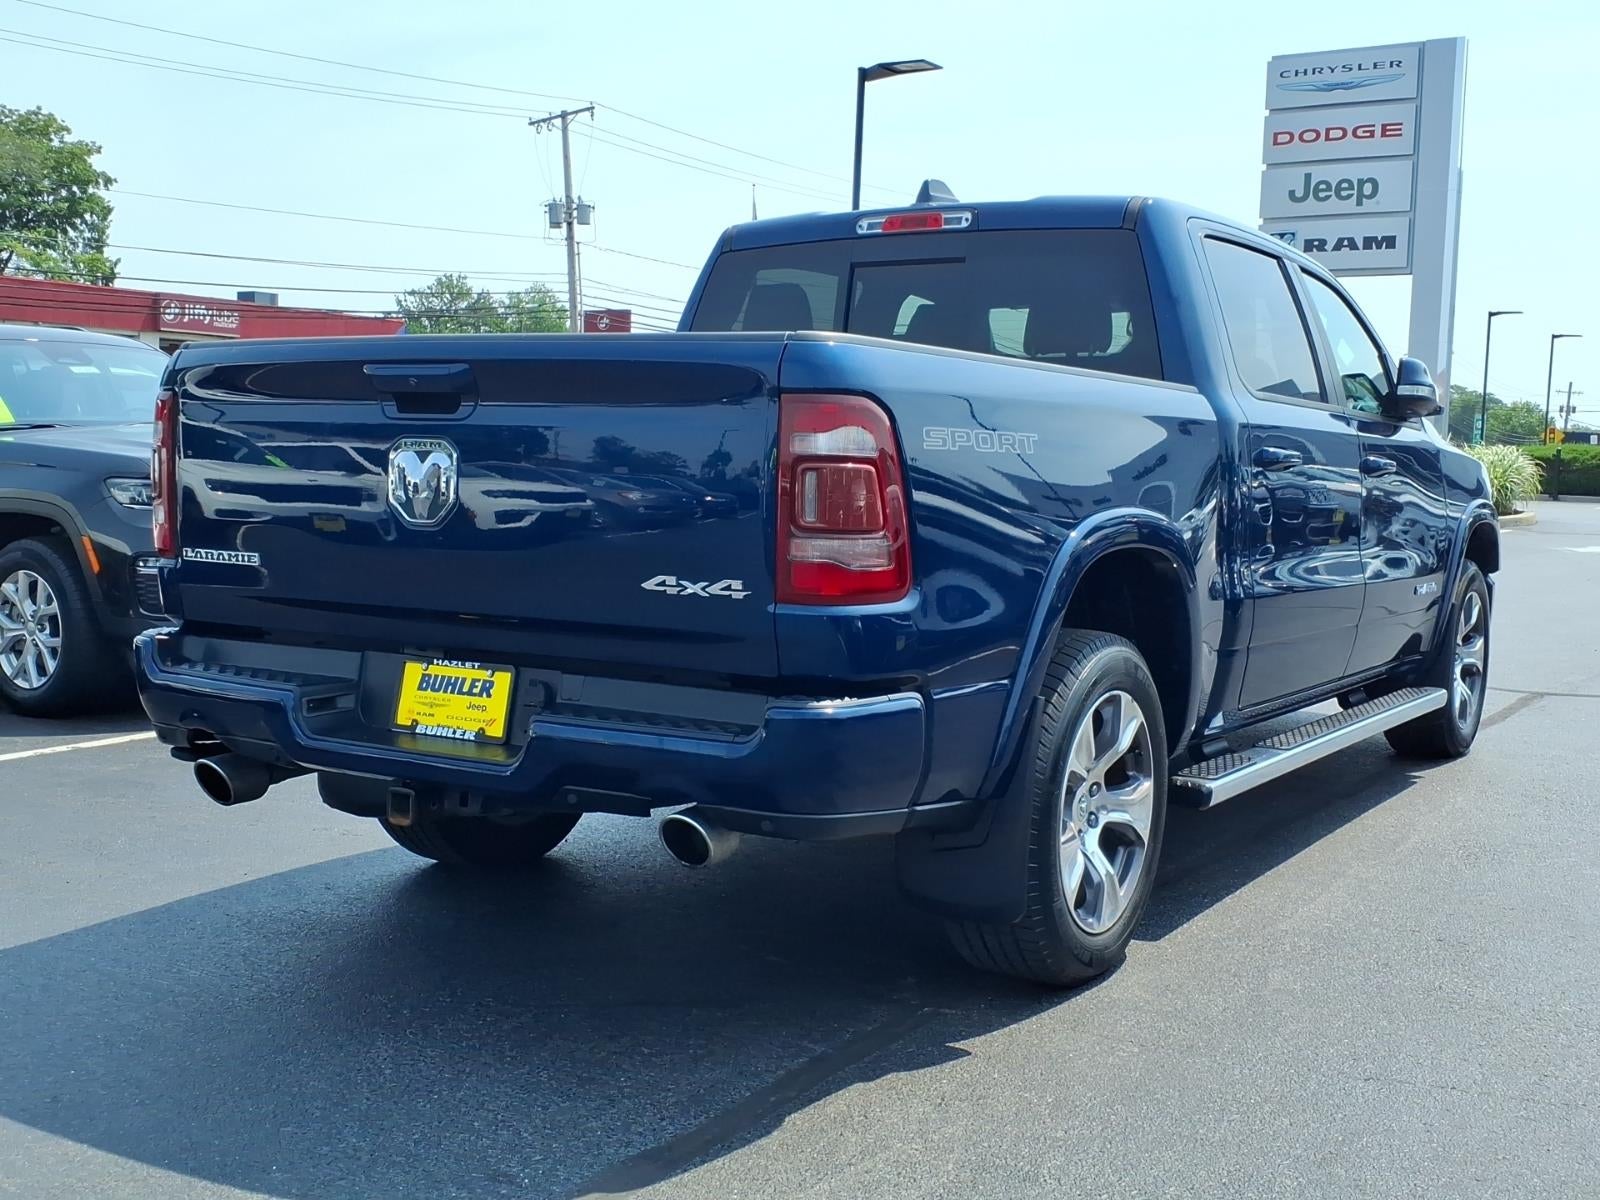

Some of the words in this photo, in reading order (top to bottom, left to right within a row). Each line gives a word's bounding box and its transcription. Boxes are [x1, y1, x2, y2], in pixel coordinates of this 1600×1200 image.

[1279, 60, 1404, 79] CHRYSLER
[1272, 122, 1404, 147] DODGE
[1287, 172, 1380, 207] Jeep
[1303, 235, 1397, 253] RAM
[213, 307, 240, 323] lube
[403, 440, 442, 449] RAM
[923, 426, 1039, 454] SPORT
[183, 547, 260, 566] LARAMIE
[433, 658, 481, 669] HAZLET
[417, 672, 495, 698] BUHLER
[466, 701, 488, 713] Jeep
[415, 724, 476, 740] BUHLER
